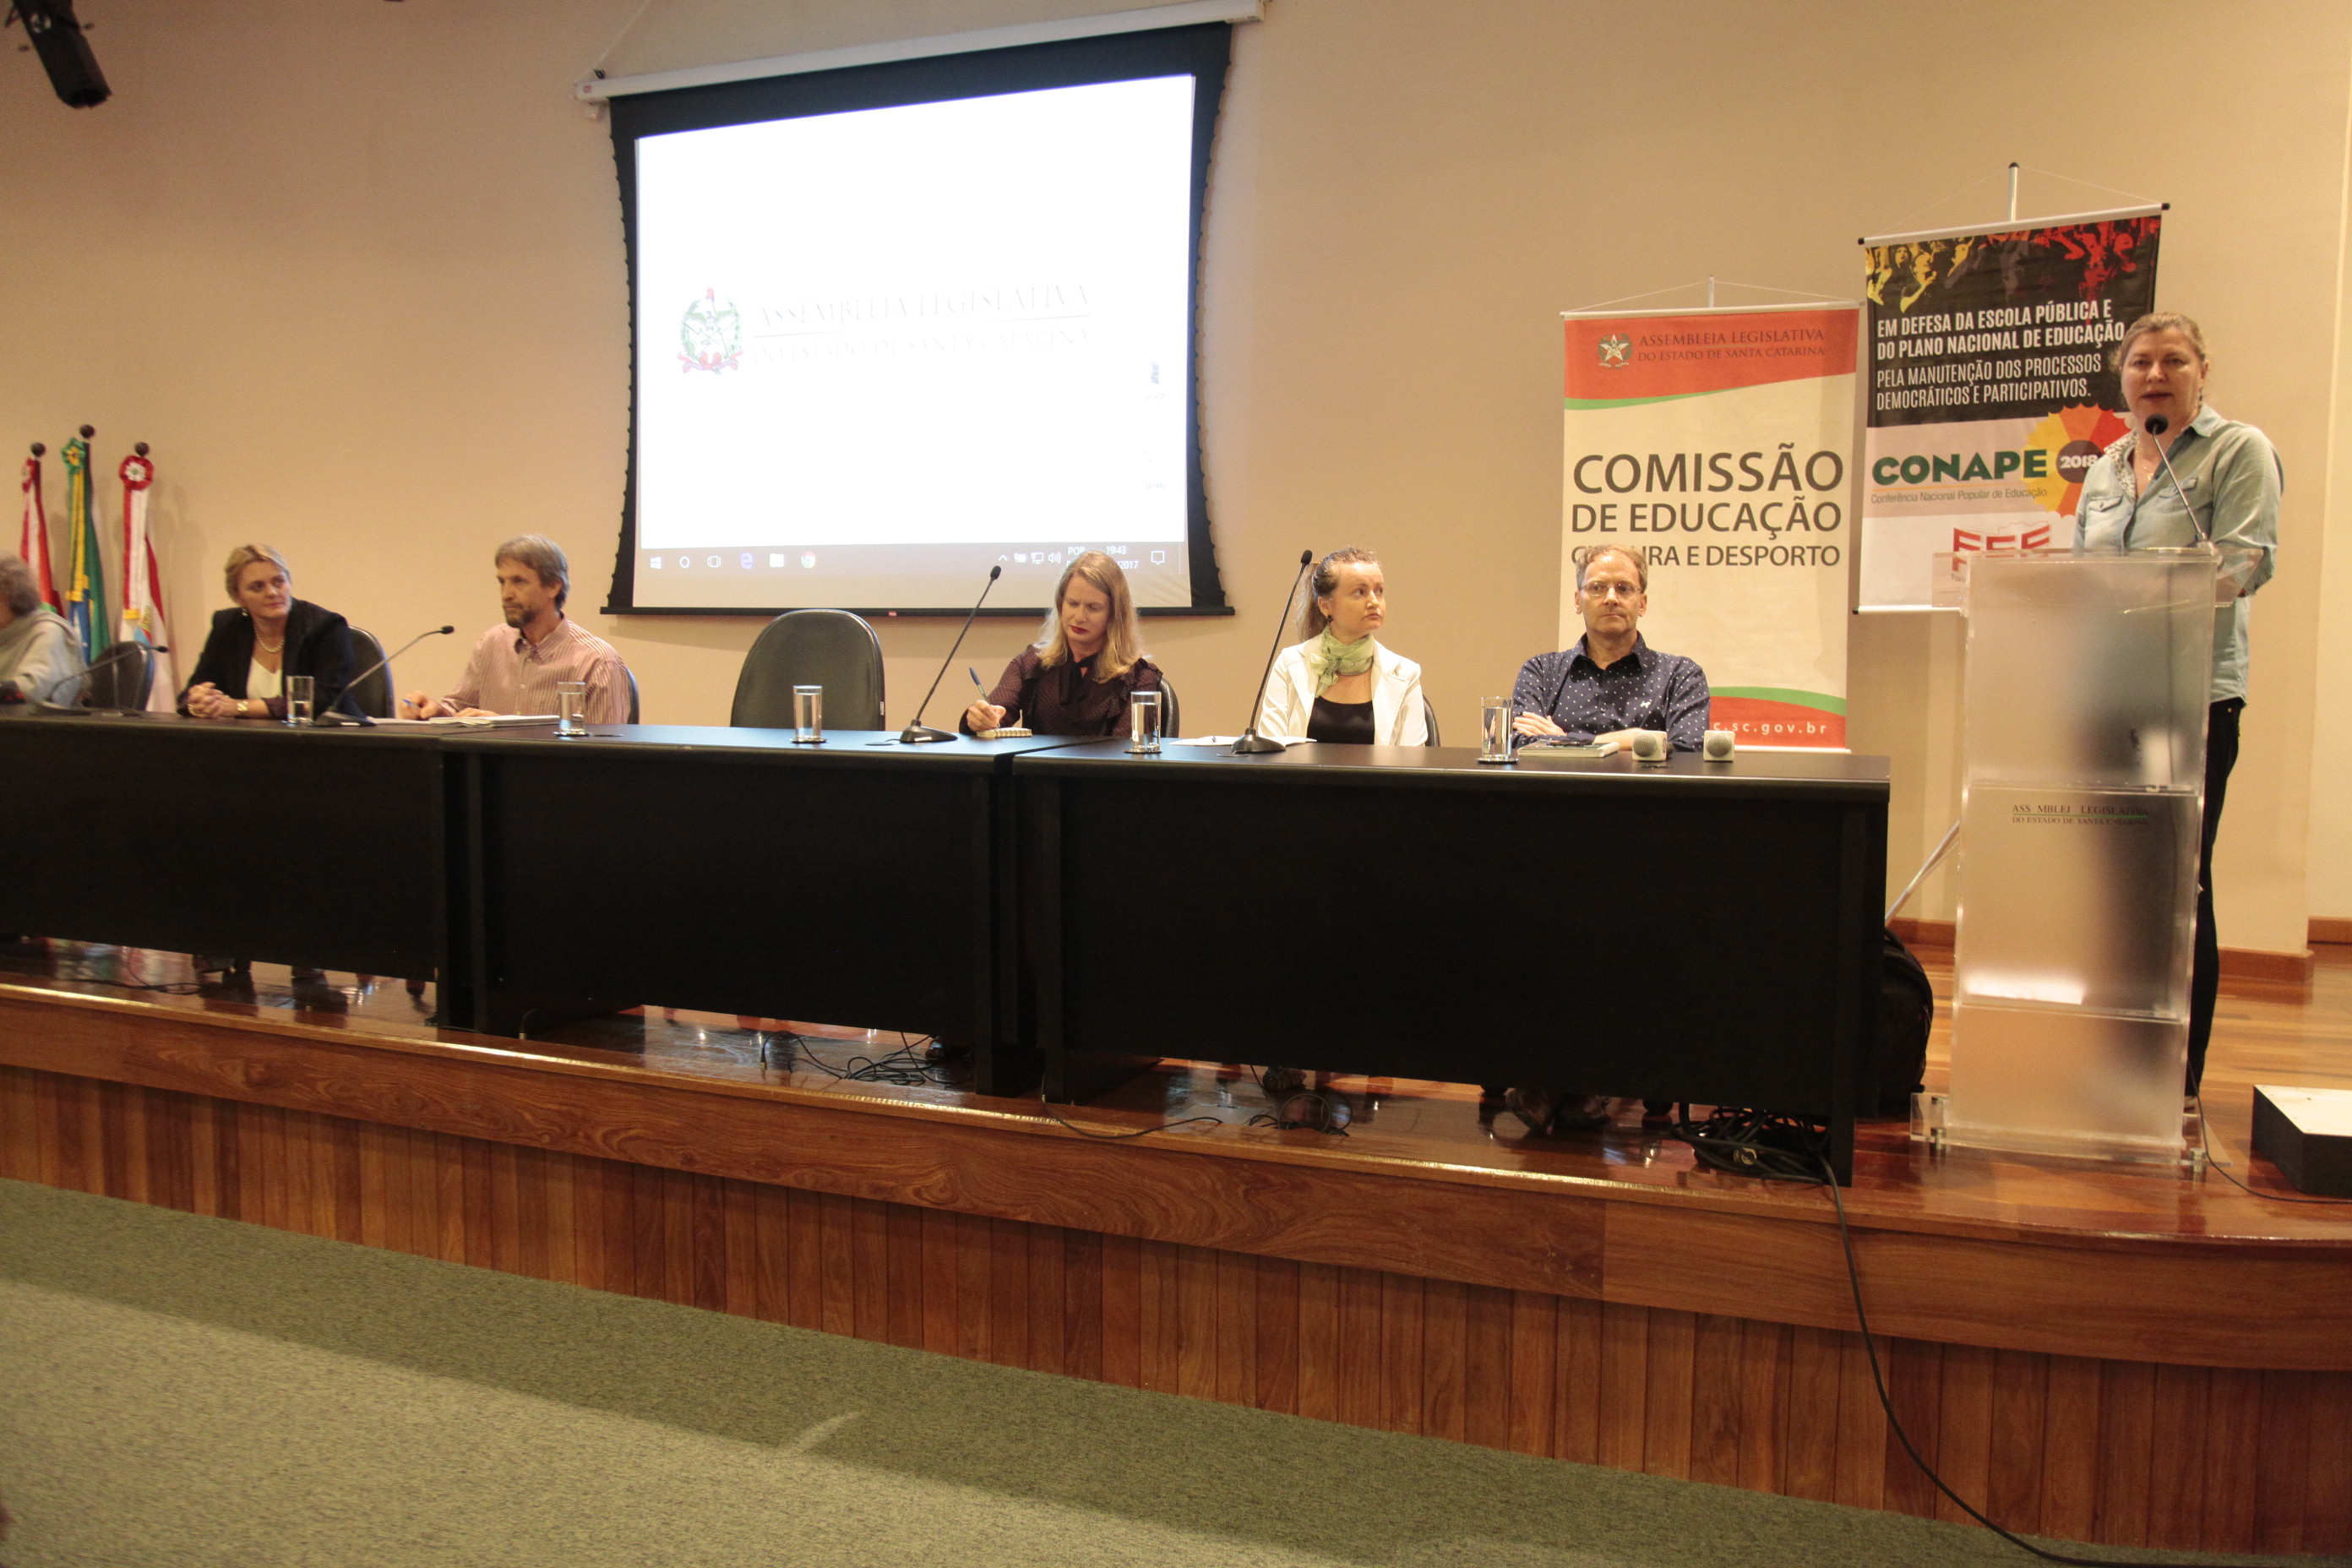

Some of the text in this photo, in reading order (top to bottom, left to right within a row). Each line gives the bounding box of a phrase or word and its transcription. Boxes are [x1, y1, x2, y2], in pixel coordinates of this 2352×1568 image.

[1877, 299, 2112, 338] EM DEFESA DA ESCOLA PÚBLICA E
[1638, 346, 1825, 362] DO ESTADO DE SANTA CATARINA
[1639, 329, 1825, 347] ASSEMBLEIA LEGISLATIVA
[1877, 318, 2126, 361] DO PLANO NACIONAL DE EDUCAÇÃO
[1877, 353, 2102, 388] PELA MANUTENÇÃO DOS PROCESSOS
[1877, 378, 2091, 410] DEMOCRÁTICOS E PARTICIPATIVOS.
[1573, 443, 1843, 493] COMISSÃO
[1872, 449, 2099, 486] CONAPE 2018
[1871, 487, 2047, 504] Conferência Nacional Popular de Educação
[1571, 496, 1842, 540] DE EDUCAÇÃO
[1686, 546, 1699, 565] E
[1707, 546, 1840, 566] DESPORTO
